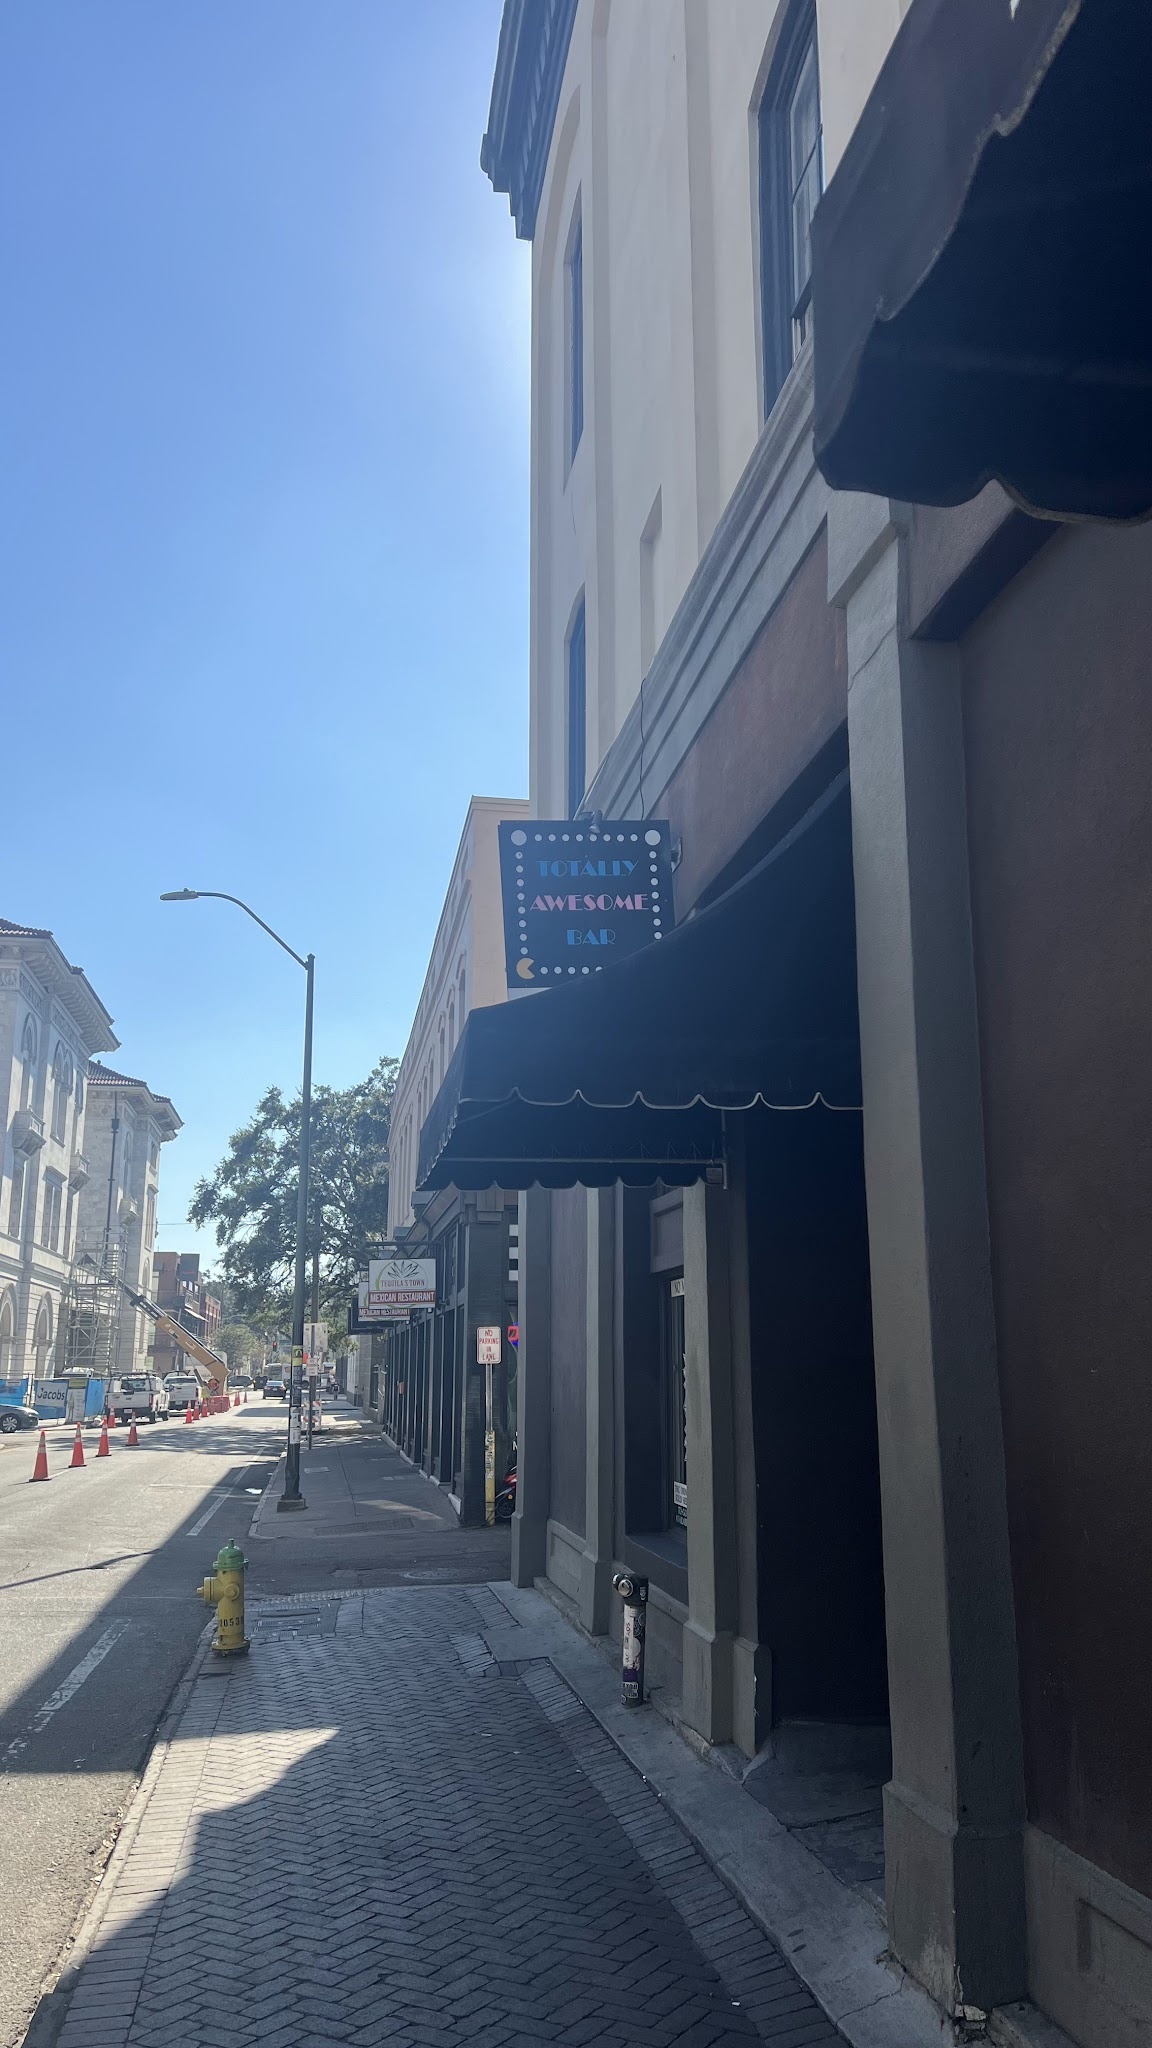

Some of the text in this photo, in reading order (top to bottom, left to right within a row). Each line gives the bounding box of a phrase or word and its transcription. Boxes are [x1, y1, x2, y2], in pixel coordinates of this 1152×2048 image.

[536, 860, 639, 877] TOTALLY
[530, 894, 649, 911] AWESOME
[566, 929, 616, 945] BAR
[409, 1279, 425, 1287] TOWN
[370, 1292, 434, 1303] MEXICAN RESTAURANT
[359, 1308, 410, 1316] MEXICAN RESTAURANT
[484, 1329, 493, 1337] NO
[482, 1353, 496, 1361] LANE
[38, 1388, 65, 1400] Jacobs
